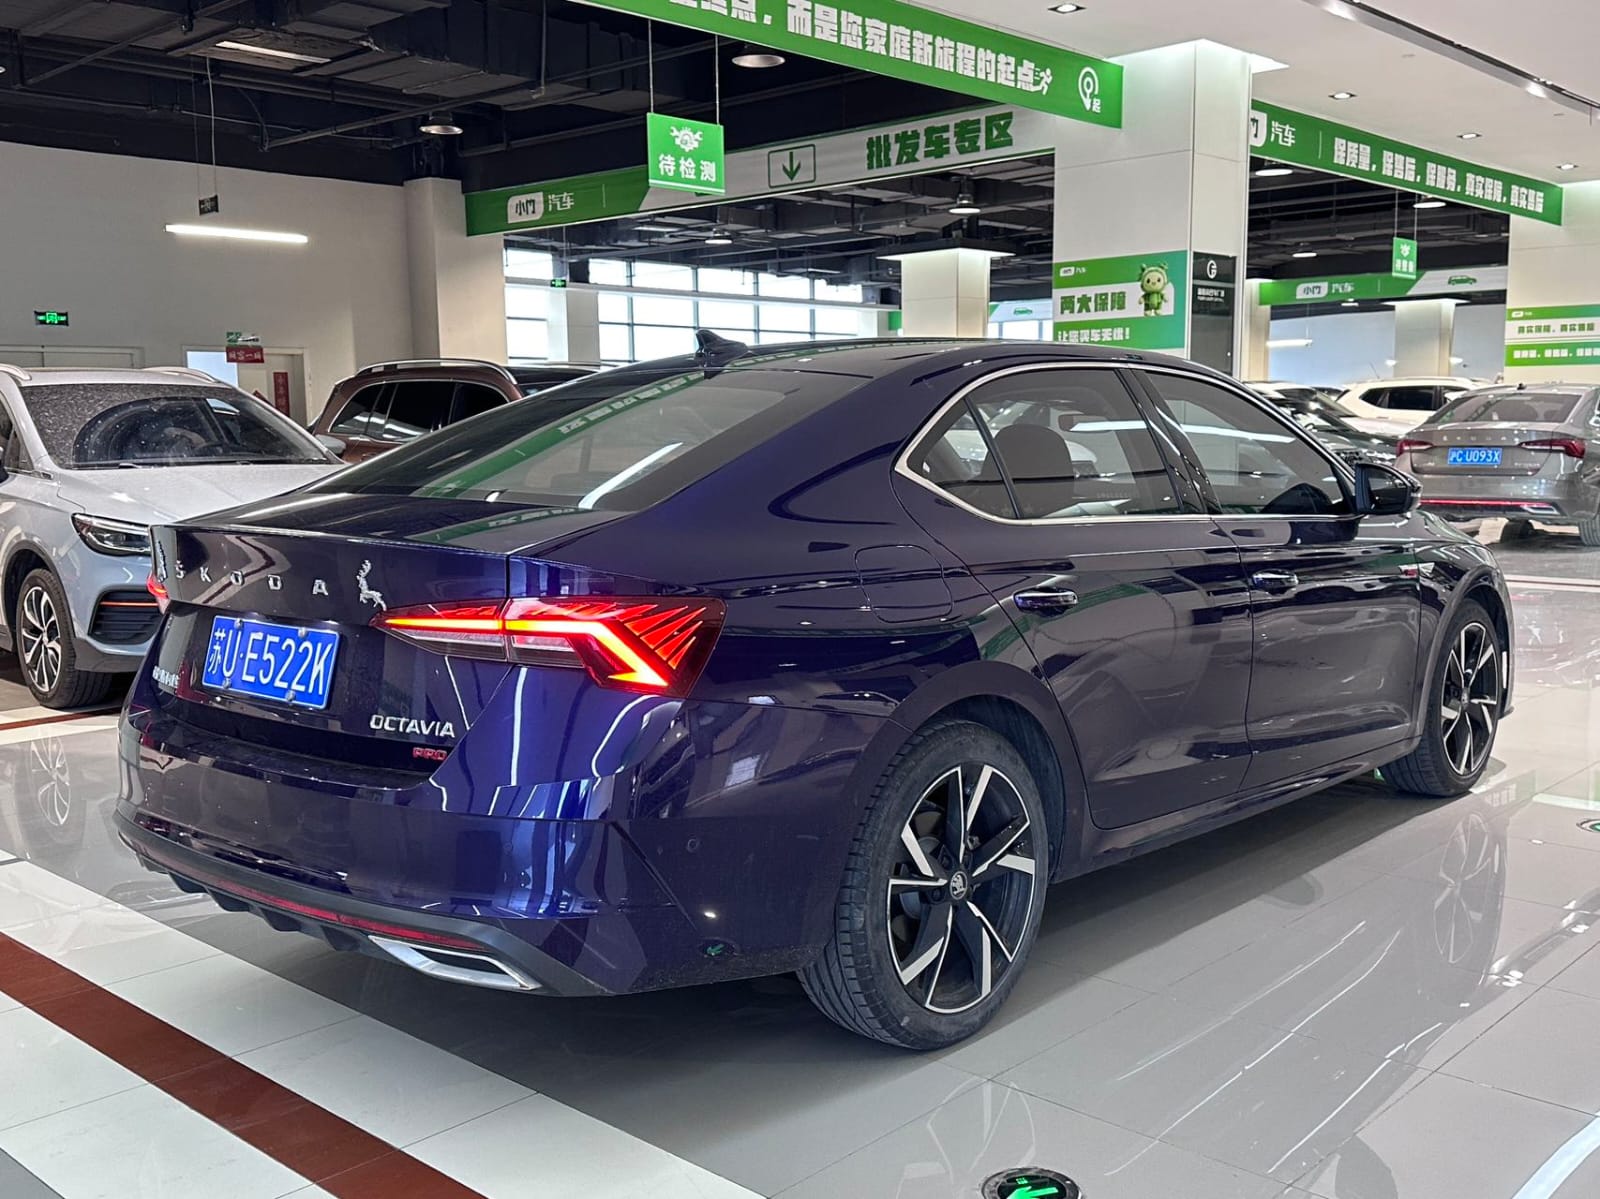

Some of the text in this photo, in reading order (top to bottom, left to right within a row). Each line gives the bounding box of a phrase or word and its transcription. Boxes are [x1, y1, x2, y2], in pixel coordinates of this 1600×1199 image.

[669, 0, 1036, 93] 点，而是您家庭新旅程的起点
[867, 112, 1013, 170] 批发车专区
[1270, 121, 1296, 147] 汽车
[659, 154, 716, 182] 待检测
[548, 191, 575, 212] 汽车
[1060, 291, 1126, 315] 两大保障
[370, 714, 455, 738] OCTAVIA
[412, 747, 447, 761] PRO
